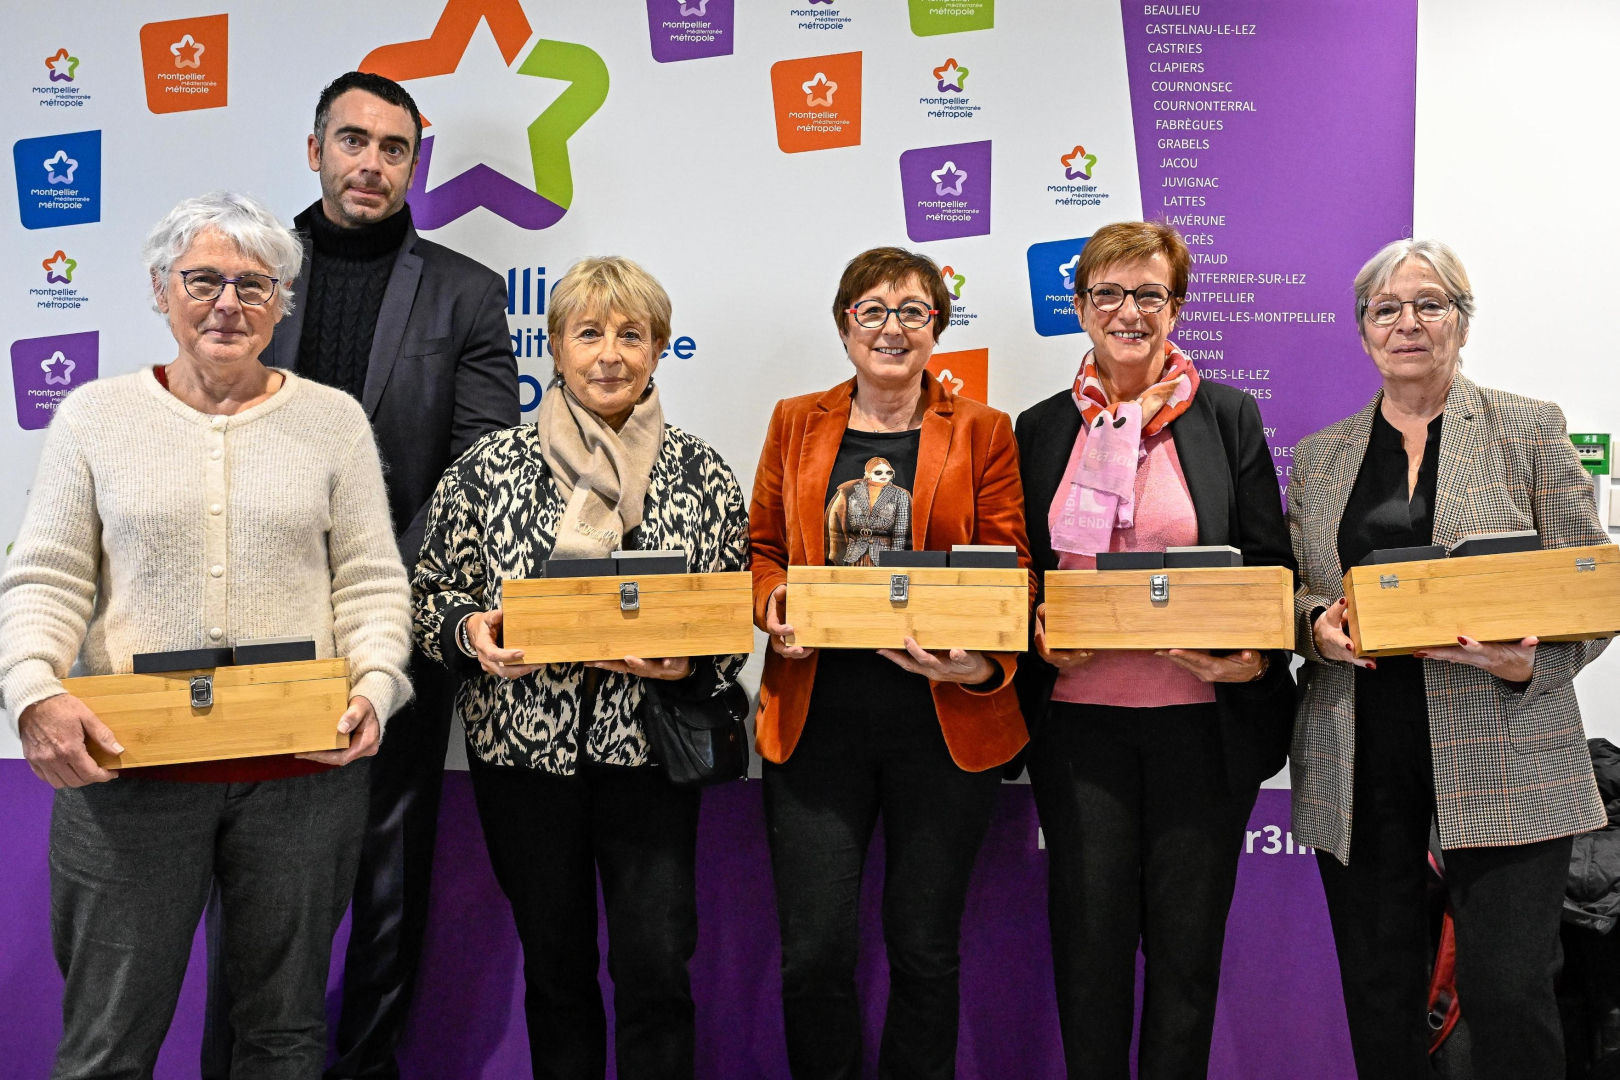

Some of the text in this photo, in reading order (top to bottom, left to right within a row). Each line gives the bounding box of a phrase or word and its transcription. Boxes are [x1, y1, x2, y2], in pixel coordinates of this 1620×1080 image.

[791, 9, 840, 17] Montpellier
[929, 7, 975, 17] Métropole
[1144, 5, 1200, 16] BEAULIEU
[662, 21, 711, 29] Montpellier
[798, 22, 844, 31] Métropole
[1146, 24, 1256, 35] CASTELNAU-LE-LEZ
[670, 34, 715, 43] Métropole
[1147, 43, 1203, 54] CASTRIES
[1149, 62, 1205, 73] CLAPIERS
[157, 73, 206, 81] Montpellier
[32, 86, 80, 95] Montpellier
[165, 86, 209, 94] Métropole
[1151, 81, 1233, 92] COURNONSEC
[39, 98, 84, 107] Métropole
[919, 97, 970, 106] Montpellier
[1153, 100, 1257, 112] COURNONTERRAL
[788, 111, 838, 119] Montpellier
[927, 110, 973, 119] Métropole
[796, 124, 842, 133] Métropole
[1155, 118, 1224, 131] FABRÈGUES
[1157, 139, 1210, 150] GRABELS
[1159, 158, 1198, 169] JACOU
[1161, 177, 1219, 188] JUVIGNAC
[30, 188, 79, 197] Montpellier
[1047, 184, 1097, 194] Montpellier
[38, 201, 83, 210] Métropole
[918, 200, 968, 209] Montpellier
[1055, 198, 1101, 207] Métropole
[1164, 196, 1206, 207] LATTES
[925, 213, 972, 222] Métropole
[1166, 213, 1226, 226] LAVÉRUNE
[1184, 232, 1214, 245] CRÈS
[1190, 254, 1228, 264] NTAUD
[1185, 273, 1307, 285] NTFERRIER-SUR-LEZ
[29, 288, 77, 297] Montpellier
[1184, 292, 1255, 303] ONTPELLIER
[37, 301, 81, 310] Métropole
[1177, 328, 1223, 341] PÉROLS
[1198, 369, 1270, 380] ADES-LE-LEZ
[1078, 516, 1112, 529] ENDL
